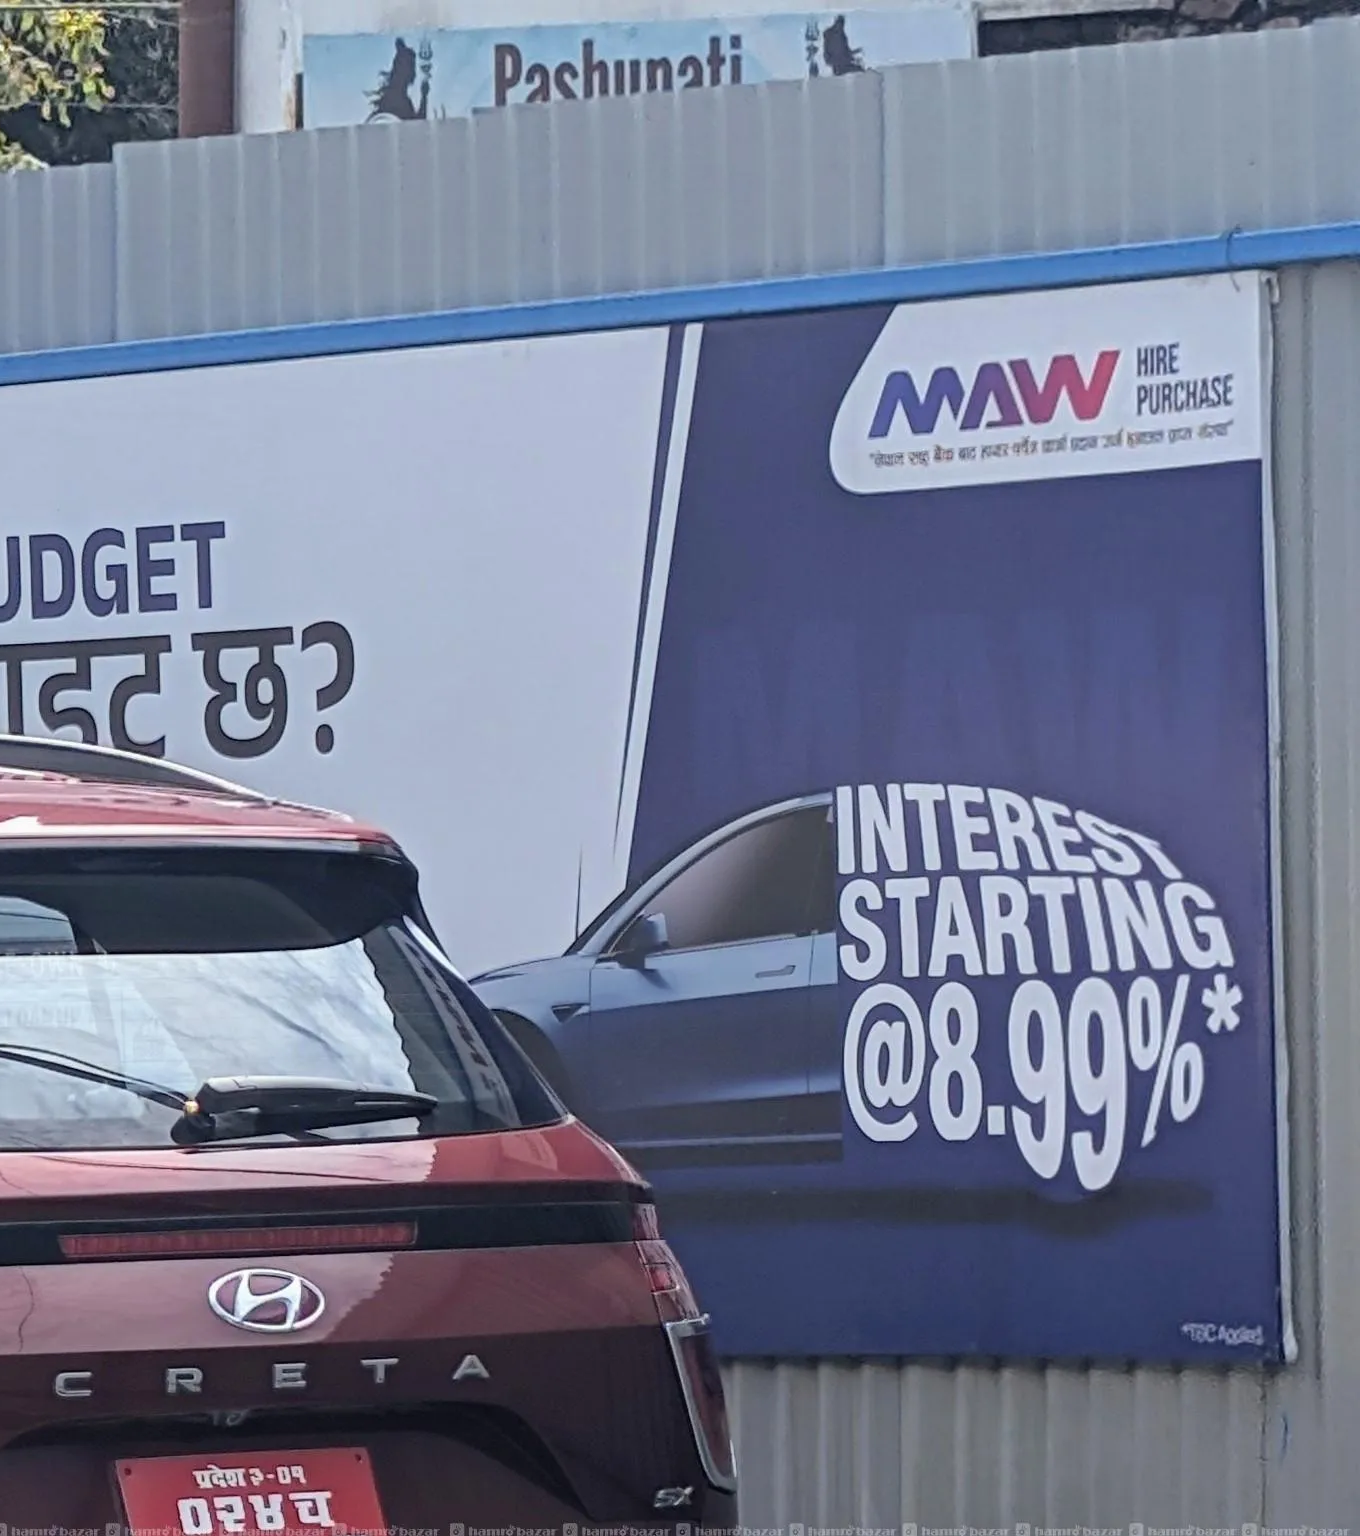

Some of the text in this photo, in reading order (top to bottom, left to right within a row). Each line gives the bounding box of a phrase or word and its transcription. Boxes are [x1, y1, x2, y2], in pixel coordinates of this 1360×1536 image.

[1136, 342, 1180, 377] HIRE
[868, 349, 1121, 439] MAW
[1135, 374, 1234, 417] PURCHASE
[835, 783, 1184, 881] INTEREST
[839, 875, 1235, 982] STARTING
[54, 1353, 492, 1399] CRETA
[192, 1464, 247, 1489] प्रदेश
[654, 1486, 693, 1508] SX
